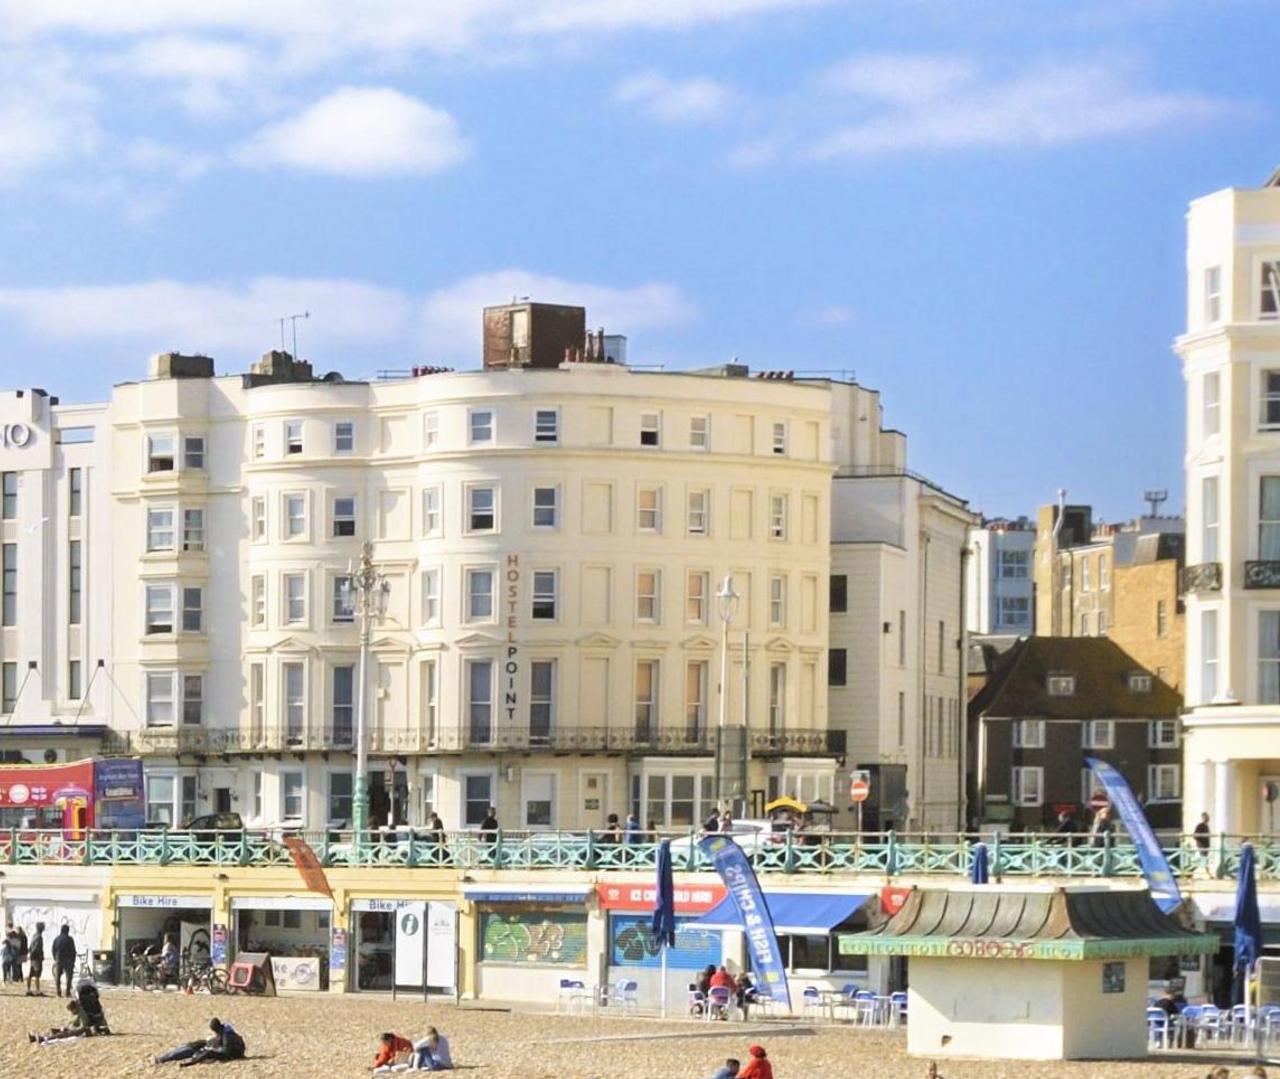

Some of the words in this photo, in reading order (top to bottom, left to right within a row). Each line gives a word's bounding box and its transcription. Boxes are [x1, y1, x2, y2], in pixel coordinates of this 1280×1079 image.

[133, 895, 154, 906] Bike
[158, 895, 178, 906] Hire
[369, 899, 393, 910] Bike
[273, 960, 288, 974] ke
